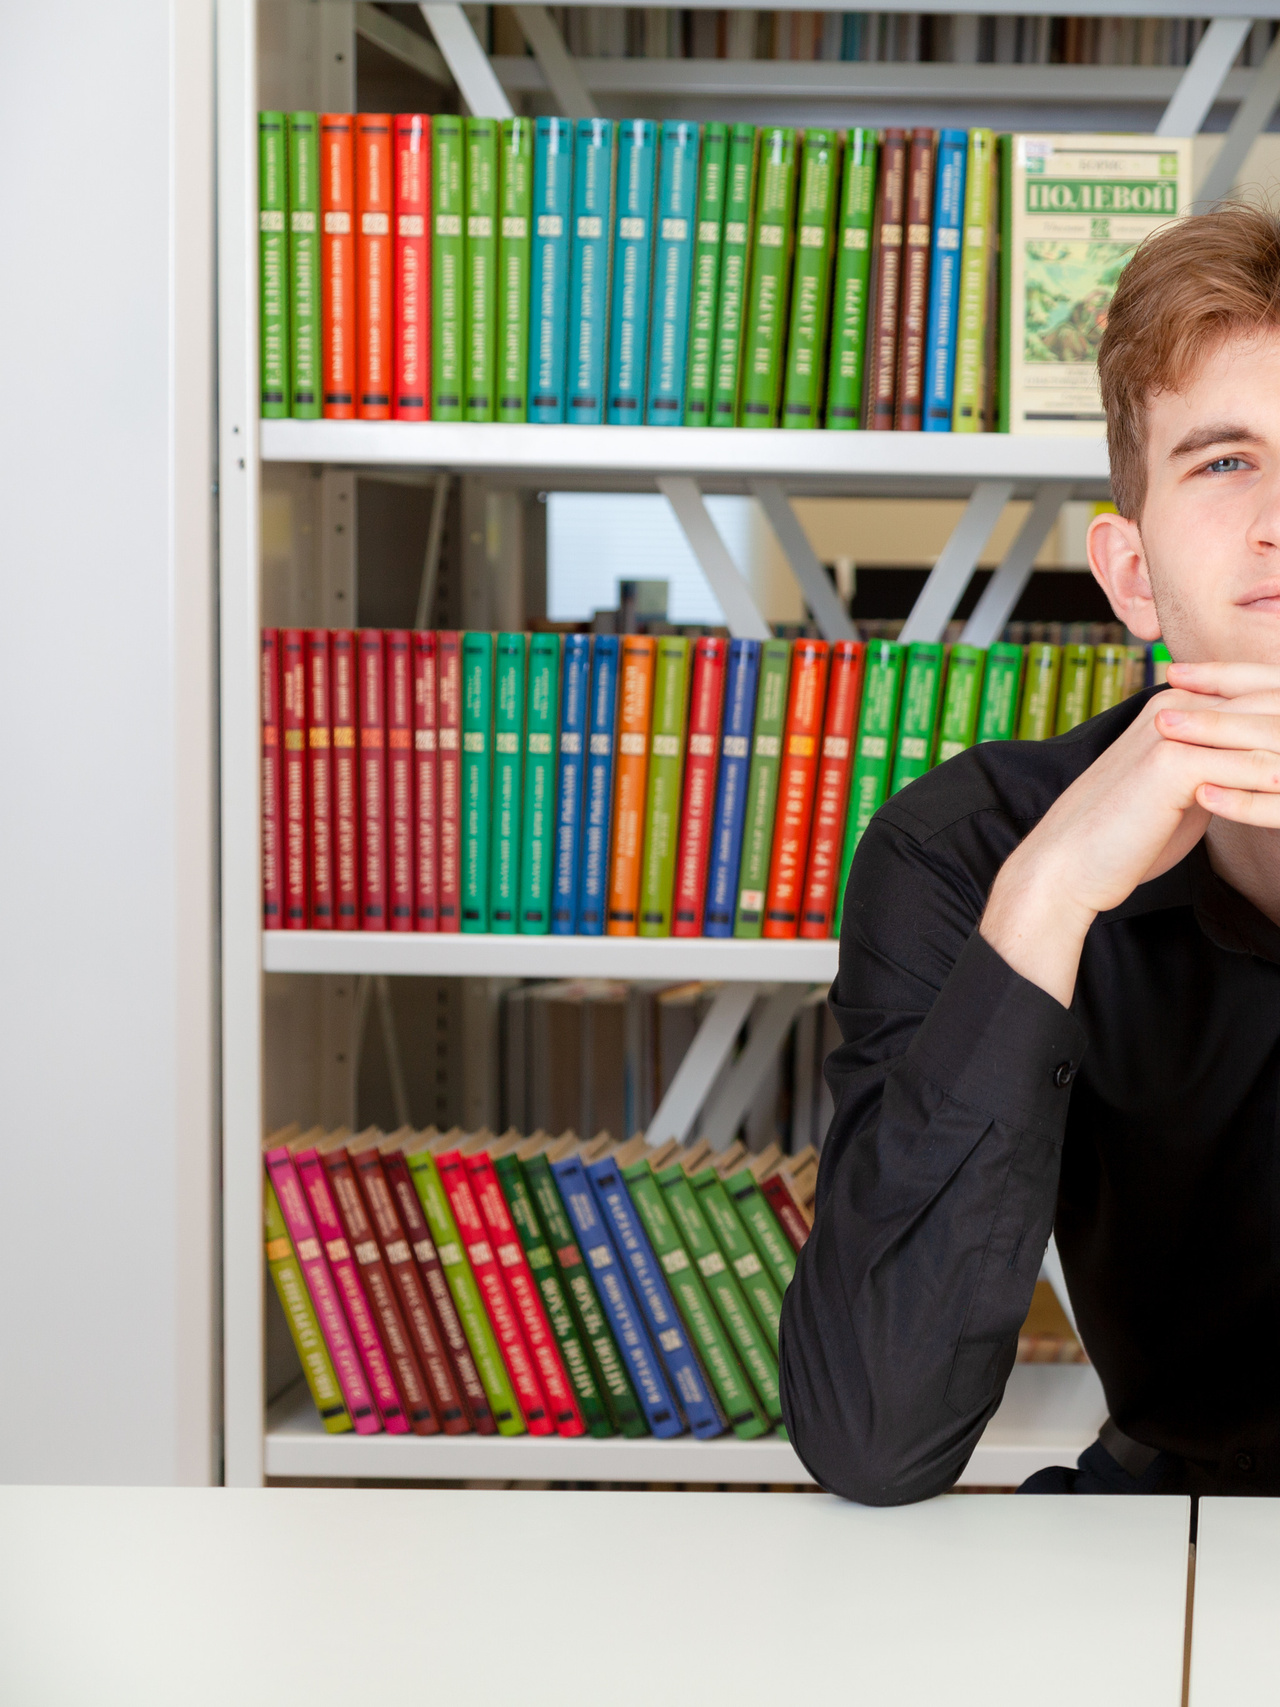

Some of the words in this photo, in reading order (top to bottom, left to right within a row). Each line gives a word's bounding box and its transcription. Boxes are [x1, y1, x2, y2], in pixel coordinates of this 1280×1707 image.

[705, 161, 717, 202] БАСНИ
[733, 162, 745, 203] БАСНИ
[1028, 181, 1174, 211] ПОЛЕВОЙ
[265, 237, 278, 315] ИЛЬИНА
[296, 238, 309, 316] ИЛЬИНА
[404, 245, 415, 322] ИСКАНДЕР
[443, 250, 453, 317] КИПЛИНГ
[473, 253, 483, 319] КИПЛИНГ
[507, 253, 519, 320] КИПЛИНГ
[542, 243, 552, 317] КОРОЛЕНКО
[581, 244, 592, 317] КОРОЛЕНКО
[623, 245, 634, 318] КОРОЛЕНКО
[664, 246, 677, 319] КОРОЛЕНКО
[695, 253, 713, 330] КРЫЛОВ
[723, 254, 740, 331] КРЫЛОВ
[758, 274, 775, 340] ЛАРРИ
[799, 274, 817, 341] ЛАРРИ
[882, 250, 897, 333] ЛЕРМОНТОВ
[908, 250, 924, 333] ЛЕРМОНТОВ
[965, 257, 979, 330] ОЛЕША
[843, 277, 861, 343] ЛАРРИ
[266, 323, 279, 385] ЕЛЕНА
[298, 323, 310, 386] ЕЛЕНА
[403, 325, 415, 384] ФАЗИЛЬ
[443, 321, 453, 379] РЕДЬЯРД
[472, 323, 483, 381] РЕДЬЯРД
[506, 323, 518, 381] РЕДЬЯРД
[540, 318, 551, 388] ВЛАДИМИР
[579, 319, 589, 389] ВЛАДИМИР
[619, 320, 631, 390] ВЛАДИМИР
[661, 320, 673, 390] ВЛАДИМИР
[692, 337, 707, 390] ИВАН
[719, 337, 735, 390] ИВАН
[754, 346, 769, 375] ЯН
[796, 347, 811, 376] ЯН
[840, 350, 856, 378] ЯН
[879, 335, 892, 398] МИХАИЛ
[906, 336, 920, 399] МИХАИЛ
[935, 347, 946, 400] ДМИТРИЙ
[961, 337, 976, 395] ЮРИЙ
[785, 768, 805, 826] ТВЕН
[819, 768, 839, 827] ТВЕН
[777, 837, 796, 899] МАРК
[811, 838, 831, 900] МАРК
[539, 1274, 572, 1337] ЧЕХОВ
[570, 1274, 603, 1335] ЧЕХОВ
[307, 1350, 333, 1401] ИВАН
[562, 1337, 594, 1401] АНТОН
[593, 1335, 626, 1398] АНТОН
